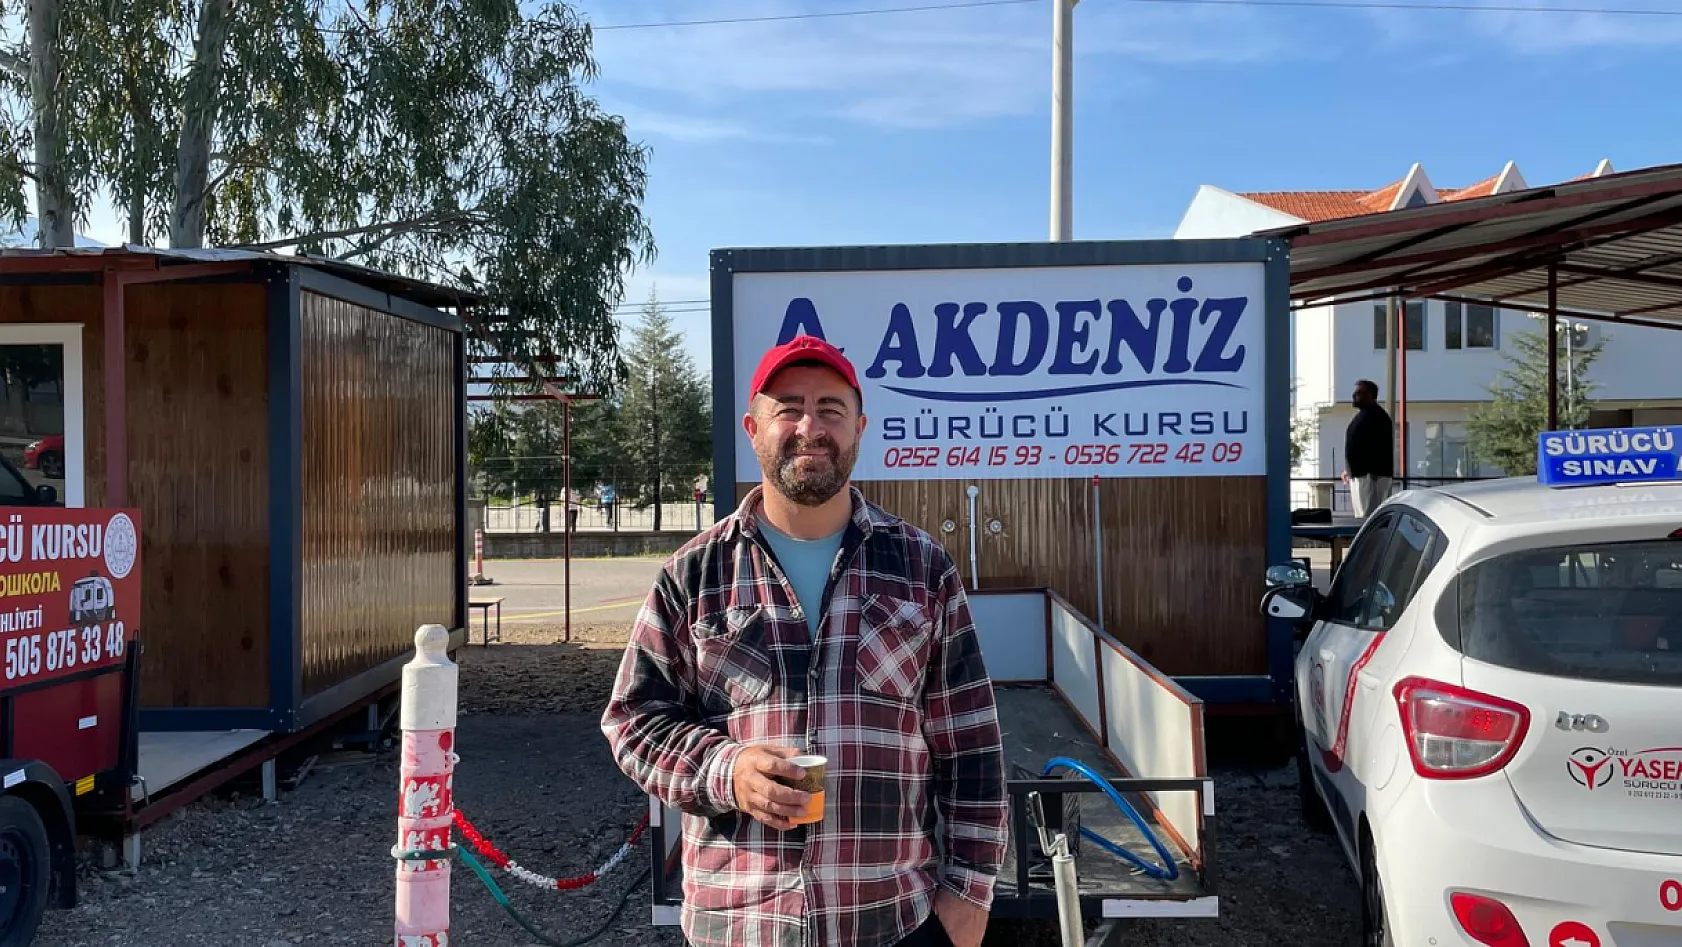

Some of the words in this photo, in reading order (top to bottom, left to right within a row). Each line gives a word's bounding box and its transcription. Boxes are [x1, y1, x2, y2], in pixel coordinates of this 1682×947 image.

[865, 276, 1248, 378] AKDENİZ
[883, 406, 1069, 441] SÜRÜCÜ
[1093, 411, 1248, 437] KURSU
[884, 446, 939, 467] 0252
[946, 446, 981, 466] 614
[987, 446, 1008, 465] 15
[1014, 446, 1042, 465] 93
[1064, 444, 1120, 465] 0536
[1126, 444, 1168, 464] 722
[1174, 443, 1205, 463] 42
[1211, 442, 1243, 462] 09
[1546, 428, 1673, 455] SÜRÜCÜ
[1562, 459, 1657, 476] SINAV
[31, 524, 102, 560] KURSU
[0, 571, 61, 597] ОШКОЛА
[6, 635, 41, 680] 505
[47, 629, 76, 671] 875
[82, 625, 101, 664] 33
[105, 621, 124, 657] 48
